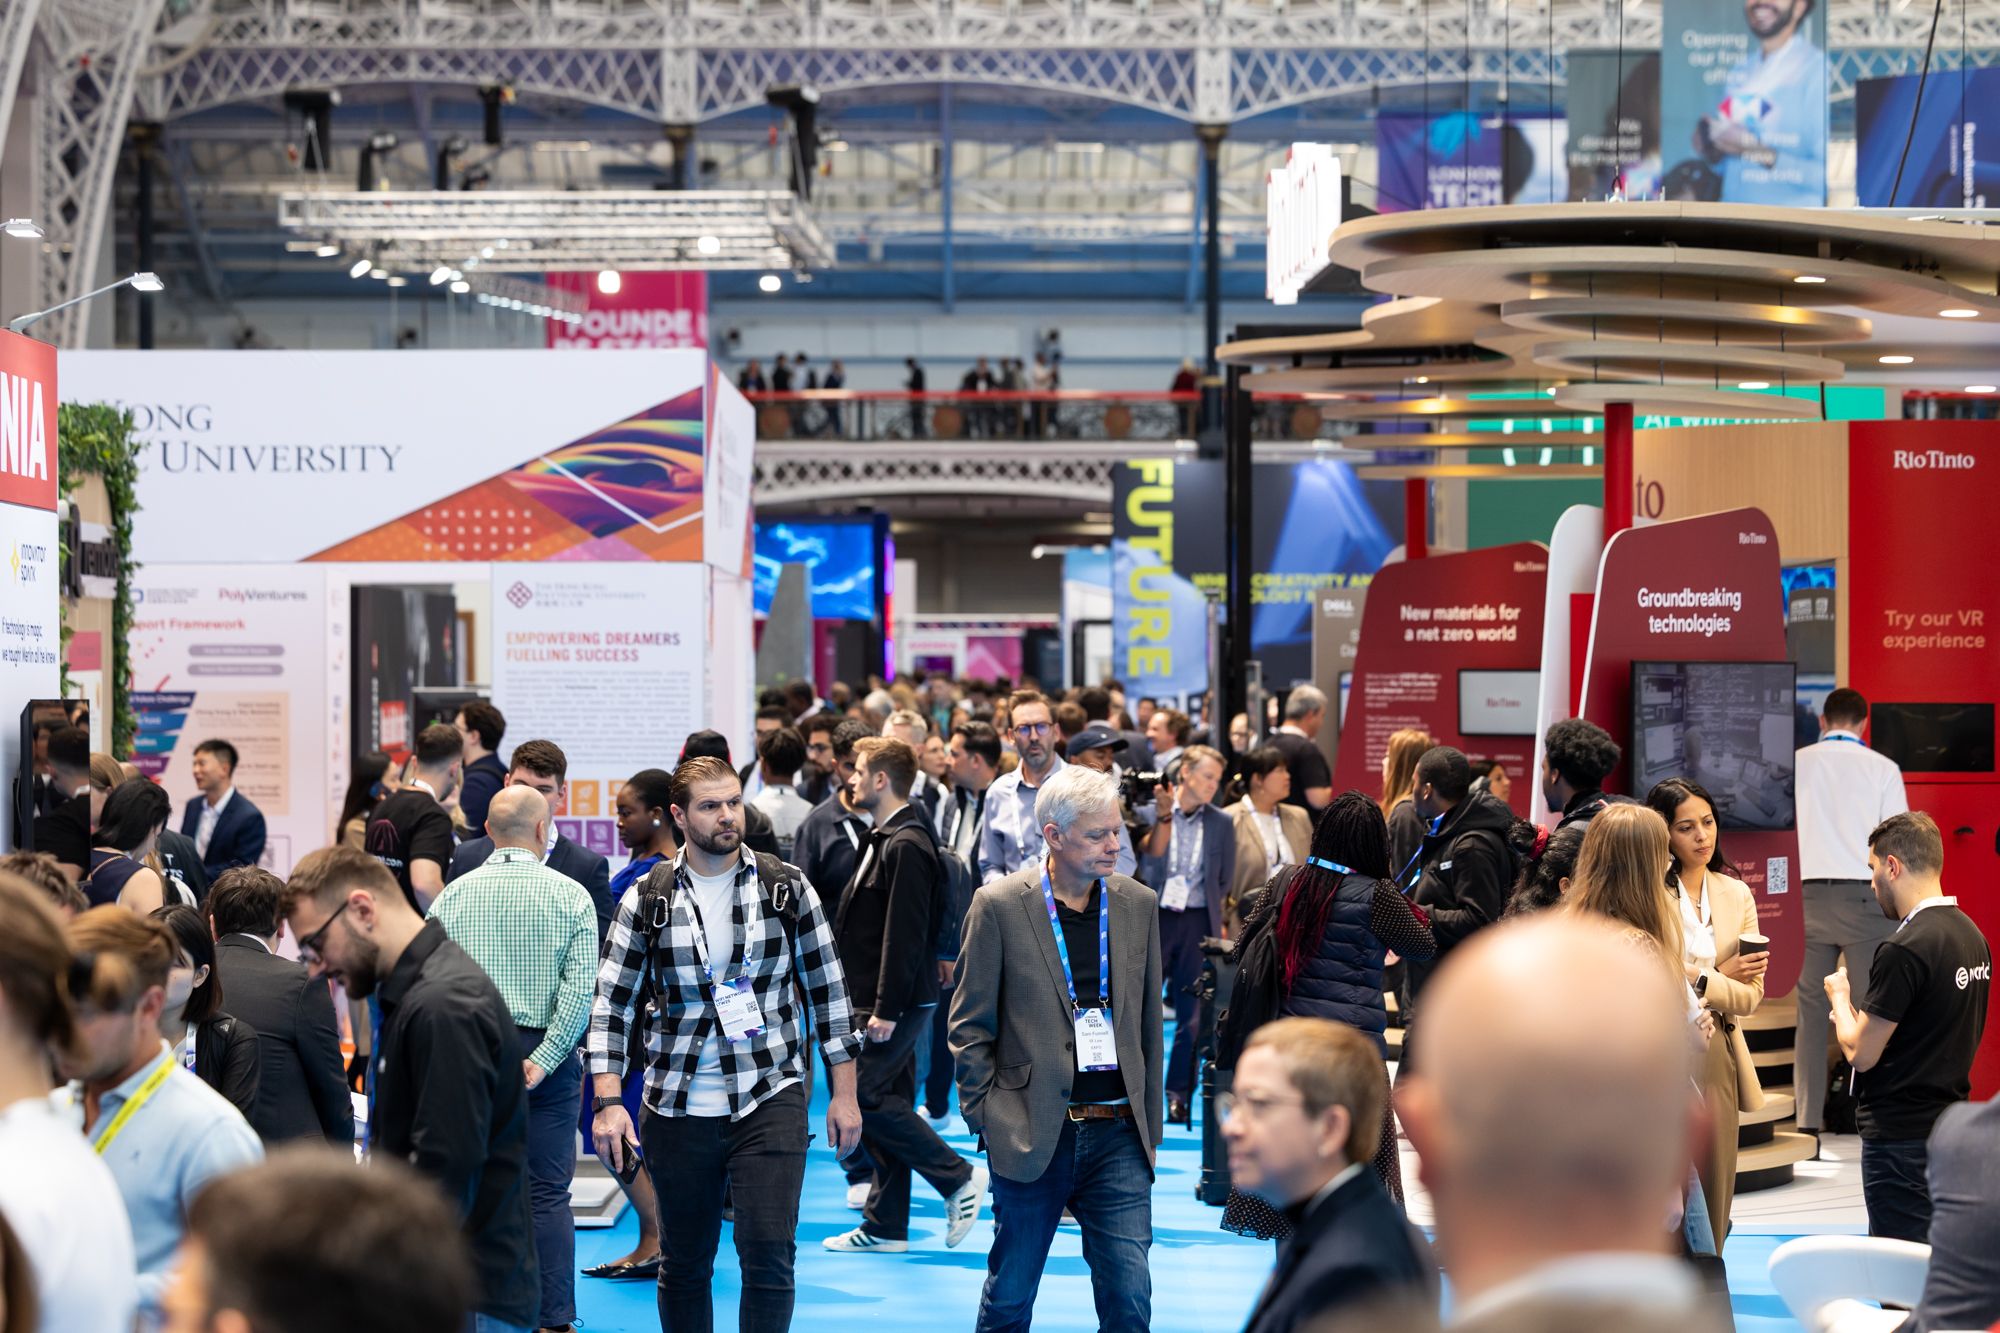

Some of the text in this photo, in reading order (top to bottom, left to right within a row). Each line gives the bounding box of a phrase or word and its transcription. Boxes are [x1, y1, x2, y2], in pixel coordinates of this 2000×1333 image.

[1682, 30, 1748, 48] Opening
[1429, 166, 1501, 181] LONDON
[1430, 184, 1501, 207] TECH
[114, 400, 213, 432] ONG
[160, 440, 402, 474] UNIVERSITY
[1126, 458, 1175, 677] FUTURE
[1637, 587, 1742, 611] Groundbreaking
[1401, 602, 1521, 621] New materials for
[1884, 609, 1984, 630] Try our VR
[169, 618, 245, 630] Framework
[1404, 625, 1517, 642] a net zero world
[1649, 613, 1731, 637] technologies
[506, 632, 681, 646] EMPOWERING DREAMERS
[1883, 632, 1985, 651] experience
[506, 649, 639, 662] FUELLING SUCCESS
